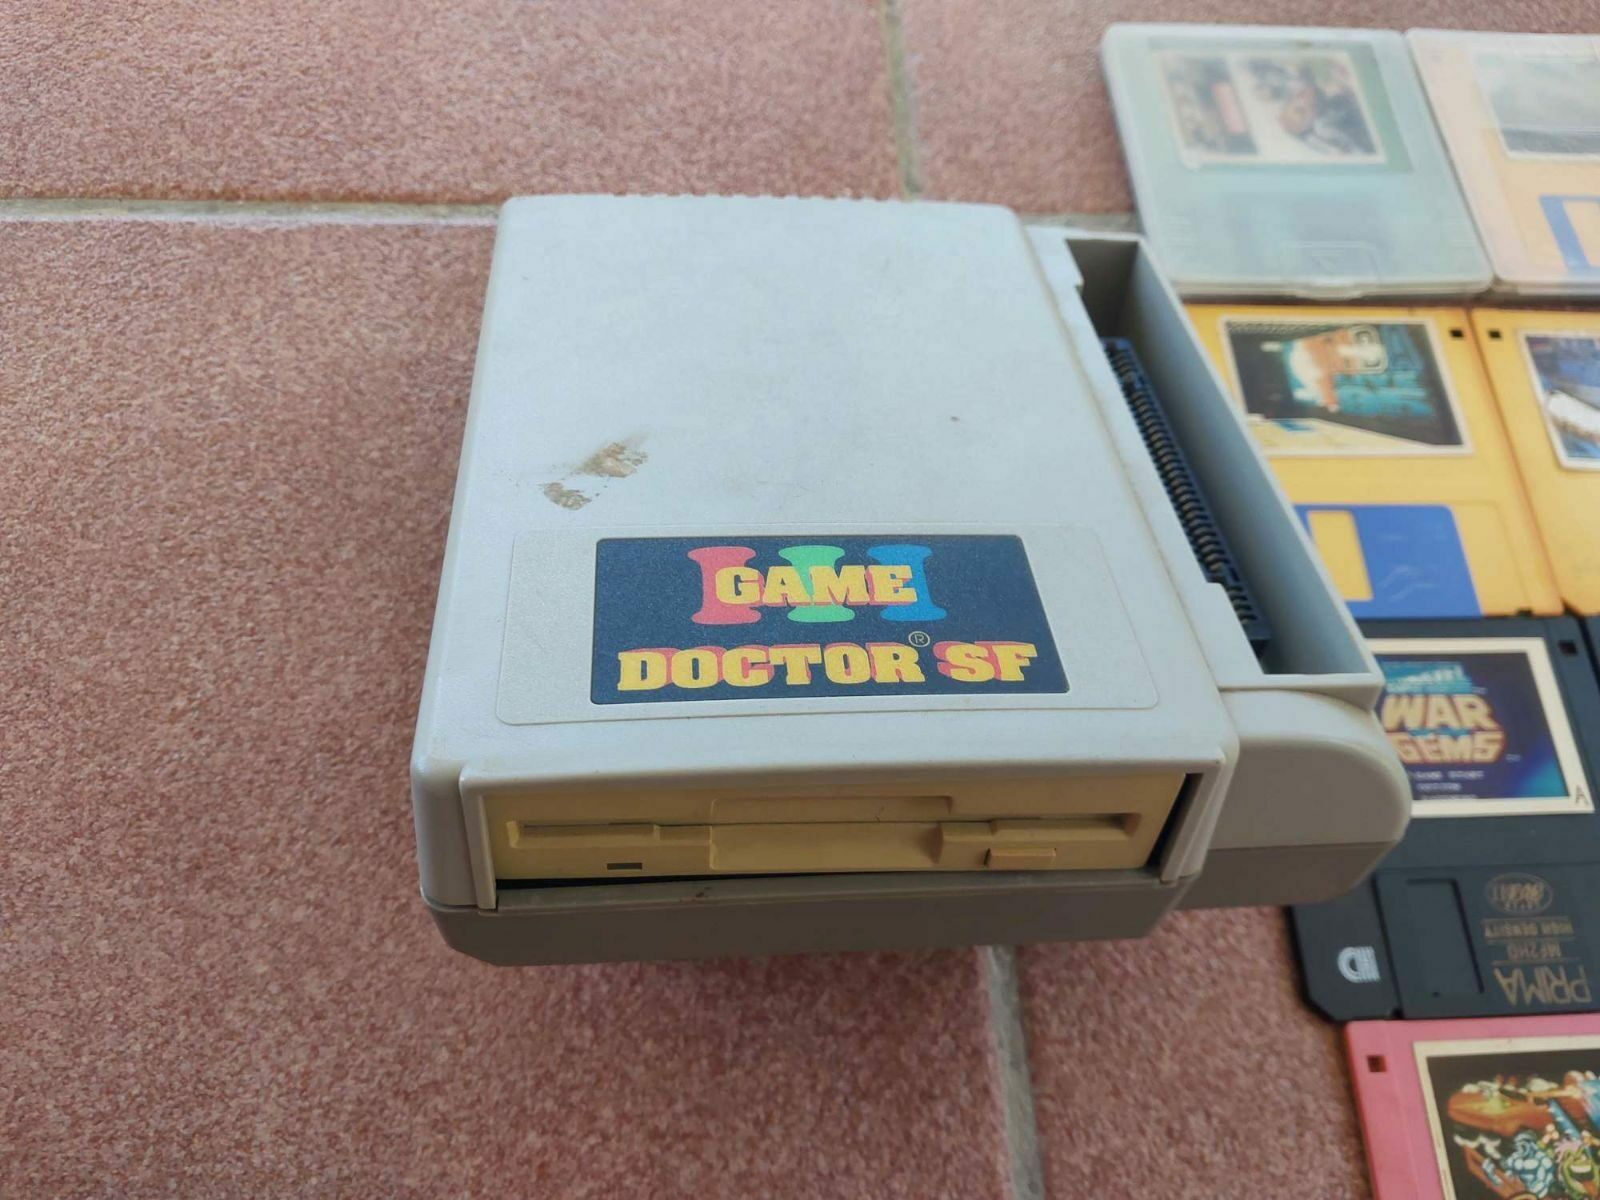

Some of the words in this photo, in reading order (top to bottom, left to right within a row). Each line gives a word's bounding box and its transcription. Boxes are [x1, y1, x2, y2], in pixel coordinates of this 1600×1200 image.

[716, 565, 918, 607] GAME
[617, 642, 926, 691] DOCTOR
[934, 641, 1038, 683] SF
[1381, 693, 1500, 732] WAR
[1389, 731, 1504, 764] GEMS
[1493, 963, 1592, 1006] PRIMA
